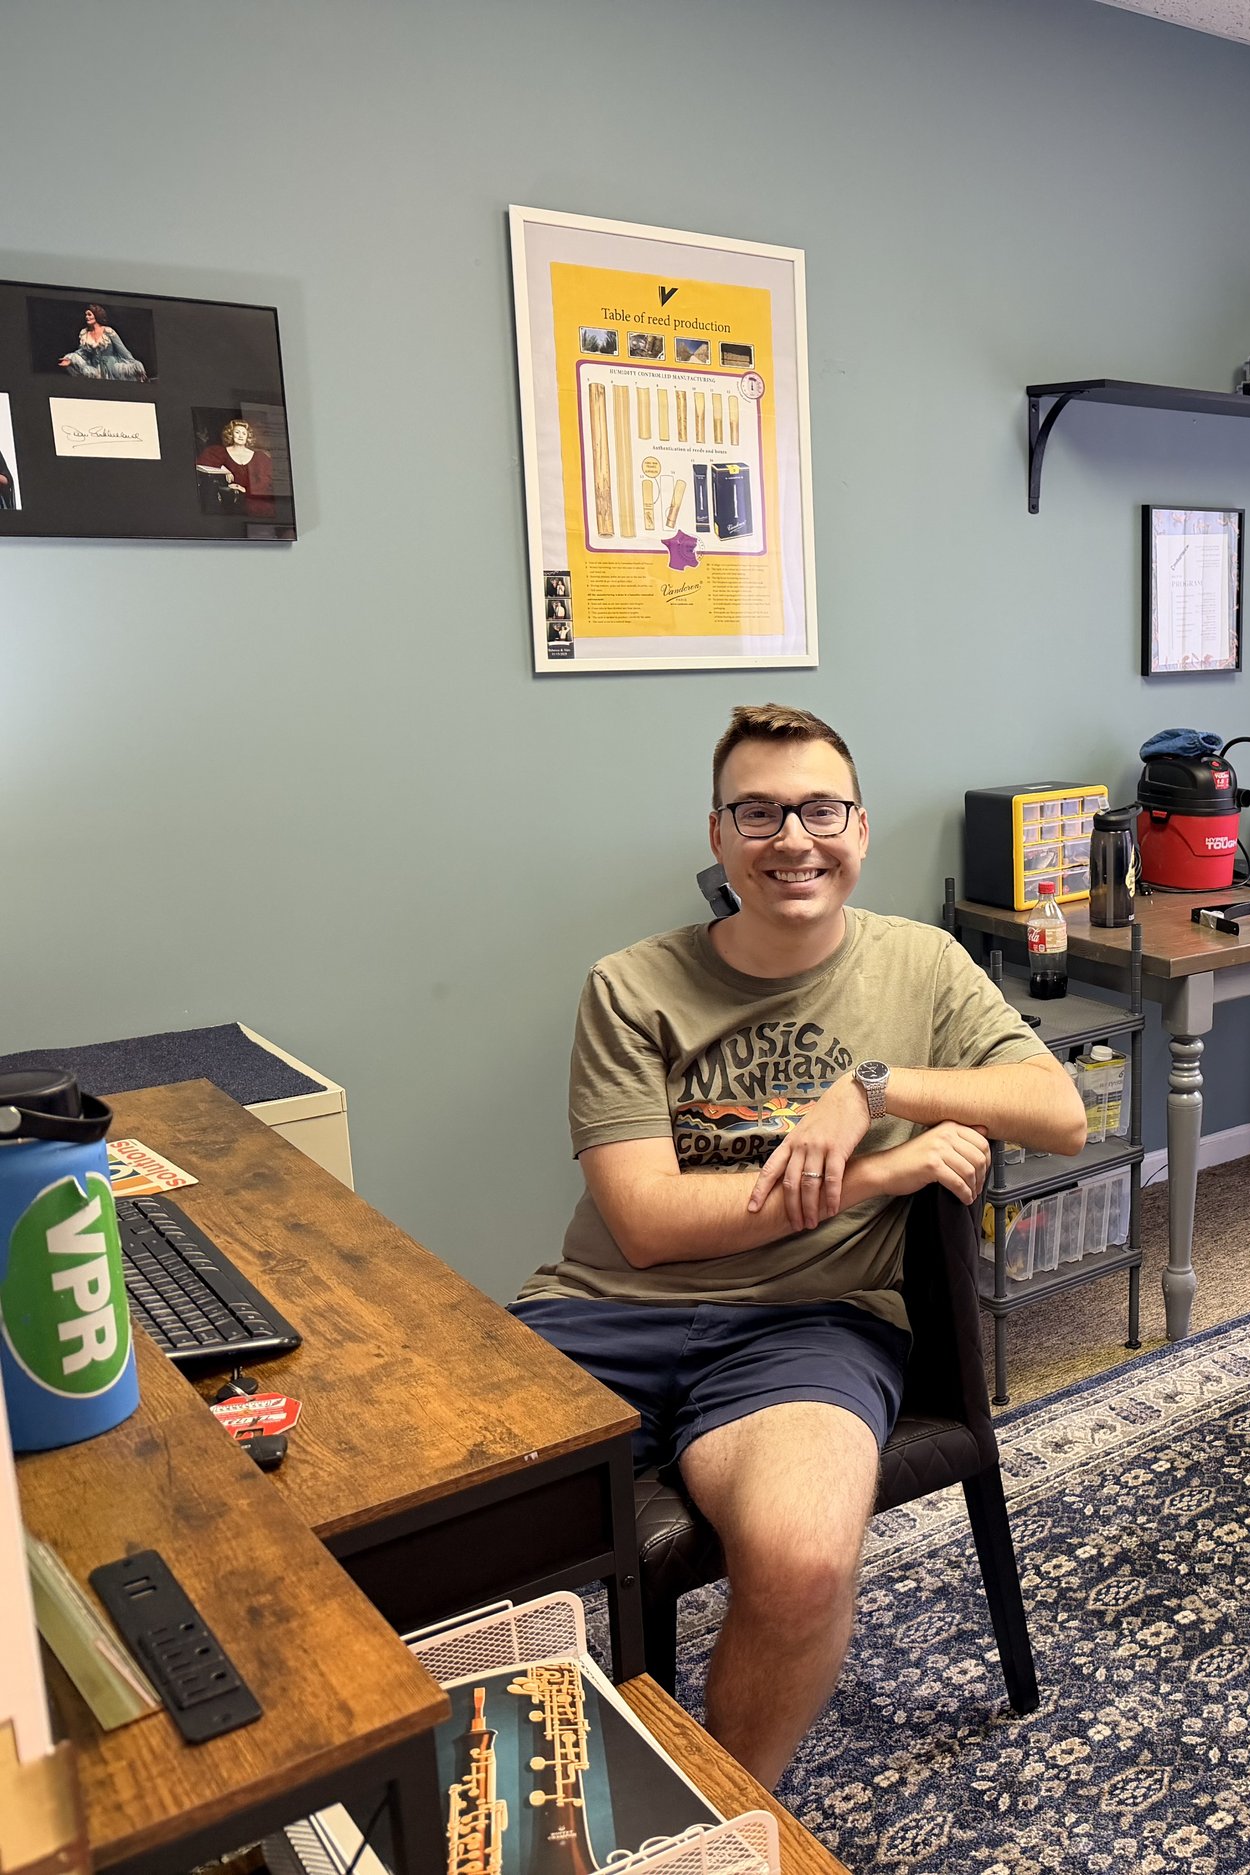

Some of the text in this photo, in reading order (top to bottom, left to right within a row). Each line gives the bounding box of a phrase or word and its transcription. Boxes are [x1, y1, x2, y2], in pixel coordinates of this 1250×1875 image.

[601, 308, 731, 334] Table of reed production
[609, 368, 637, 376] HUMIDITY
[672, 374, 716, 384] MANUFACTURING
[677, 1133, 766, 1157] COLOR
[110, 1140, 187, 1188] solutions
[45, 1195, 119, 1376] VPR
